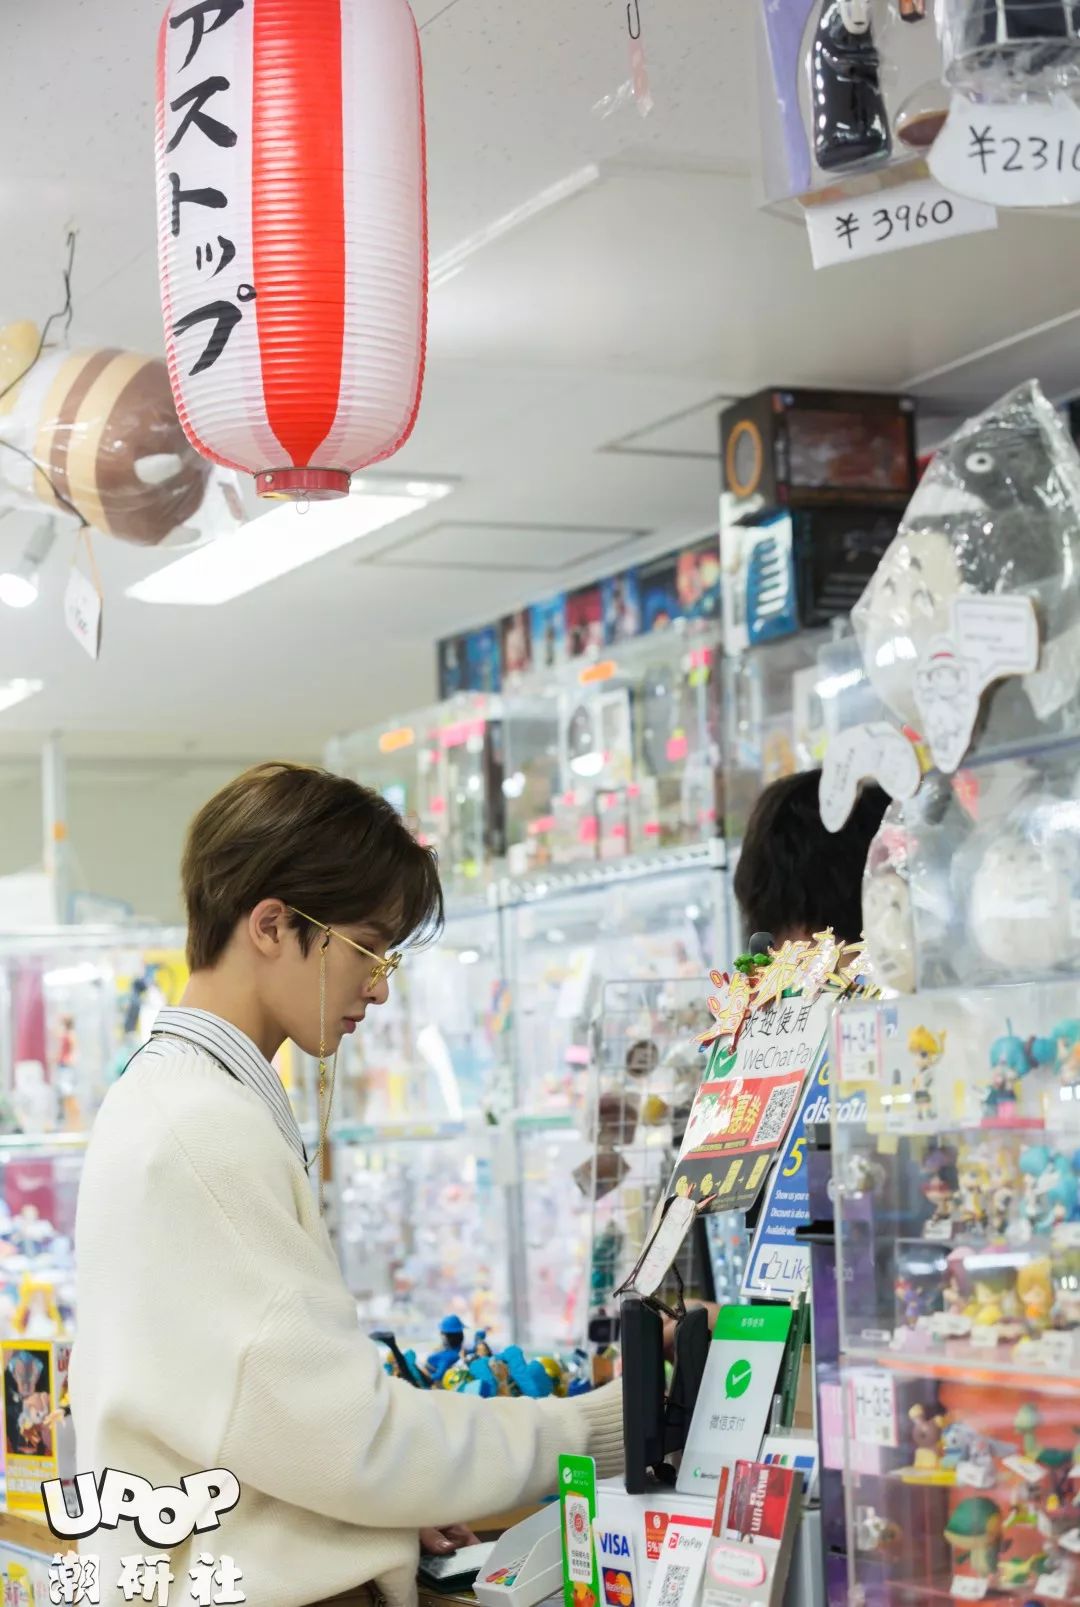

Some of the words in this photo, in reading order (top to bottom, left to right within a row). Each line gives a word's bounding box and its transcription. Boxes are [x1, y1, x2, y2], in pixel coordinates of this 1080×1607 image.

[743, 1046, 794, 1070] WeChat
[795, 1042, 816, 1065] Pay
[782, 1258, 809, 1280] Lik
[599, 1532, 631, 1557] VISA
